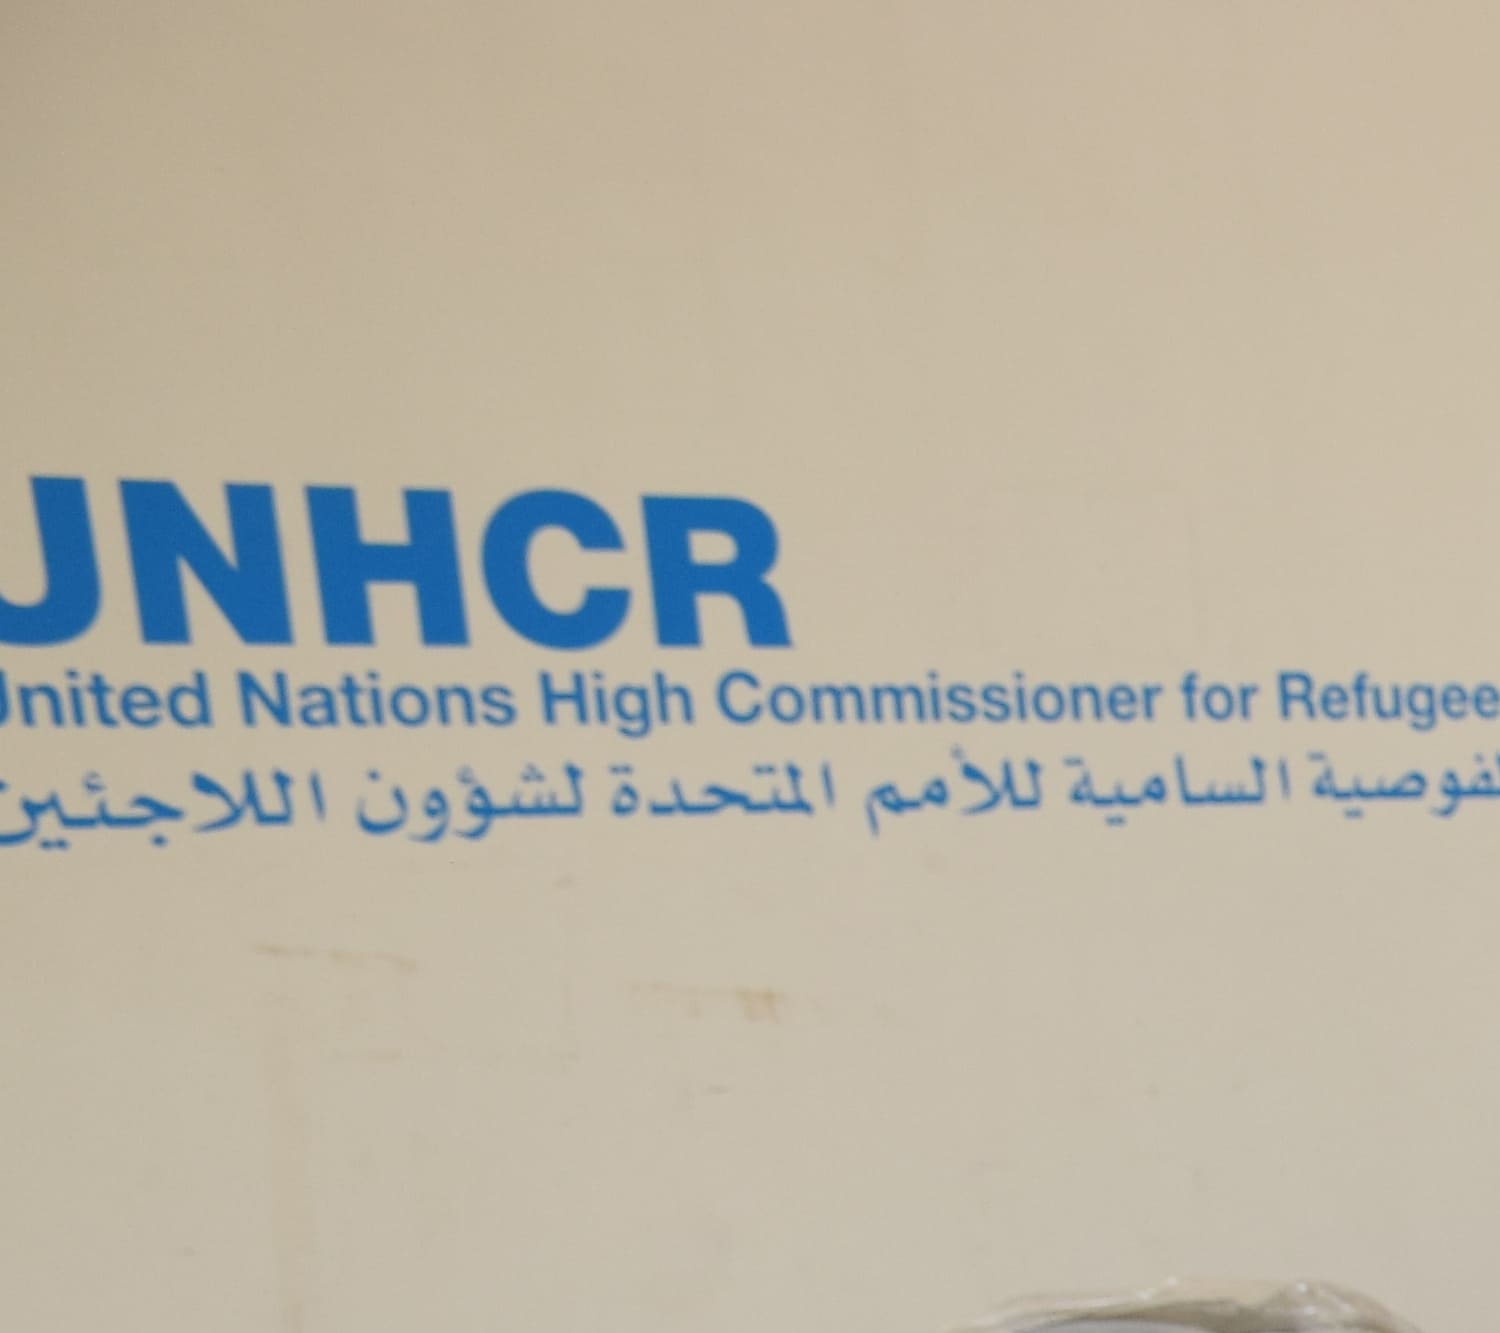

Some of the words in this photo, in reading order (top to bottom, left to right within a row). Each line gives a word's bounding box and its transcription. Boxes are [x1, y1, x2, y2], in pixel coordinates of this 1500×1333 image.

[0, 670, 213, 728] nited
[237, 670, 517, 728] Nations
[539, 671, 695, 739] High
[715, 670, 1164, 727] Commissioner
[1179, 671, 1260, 721] for
